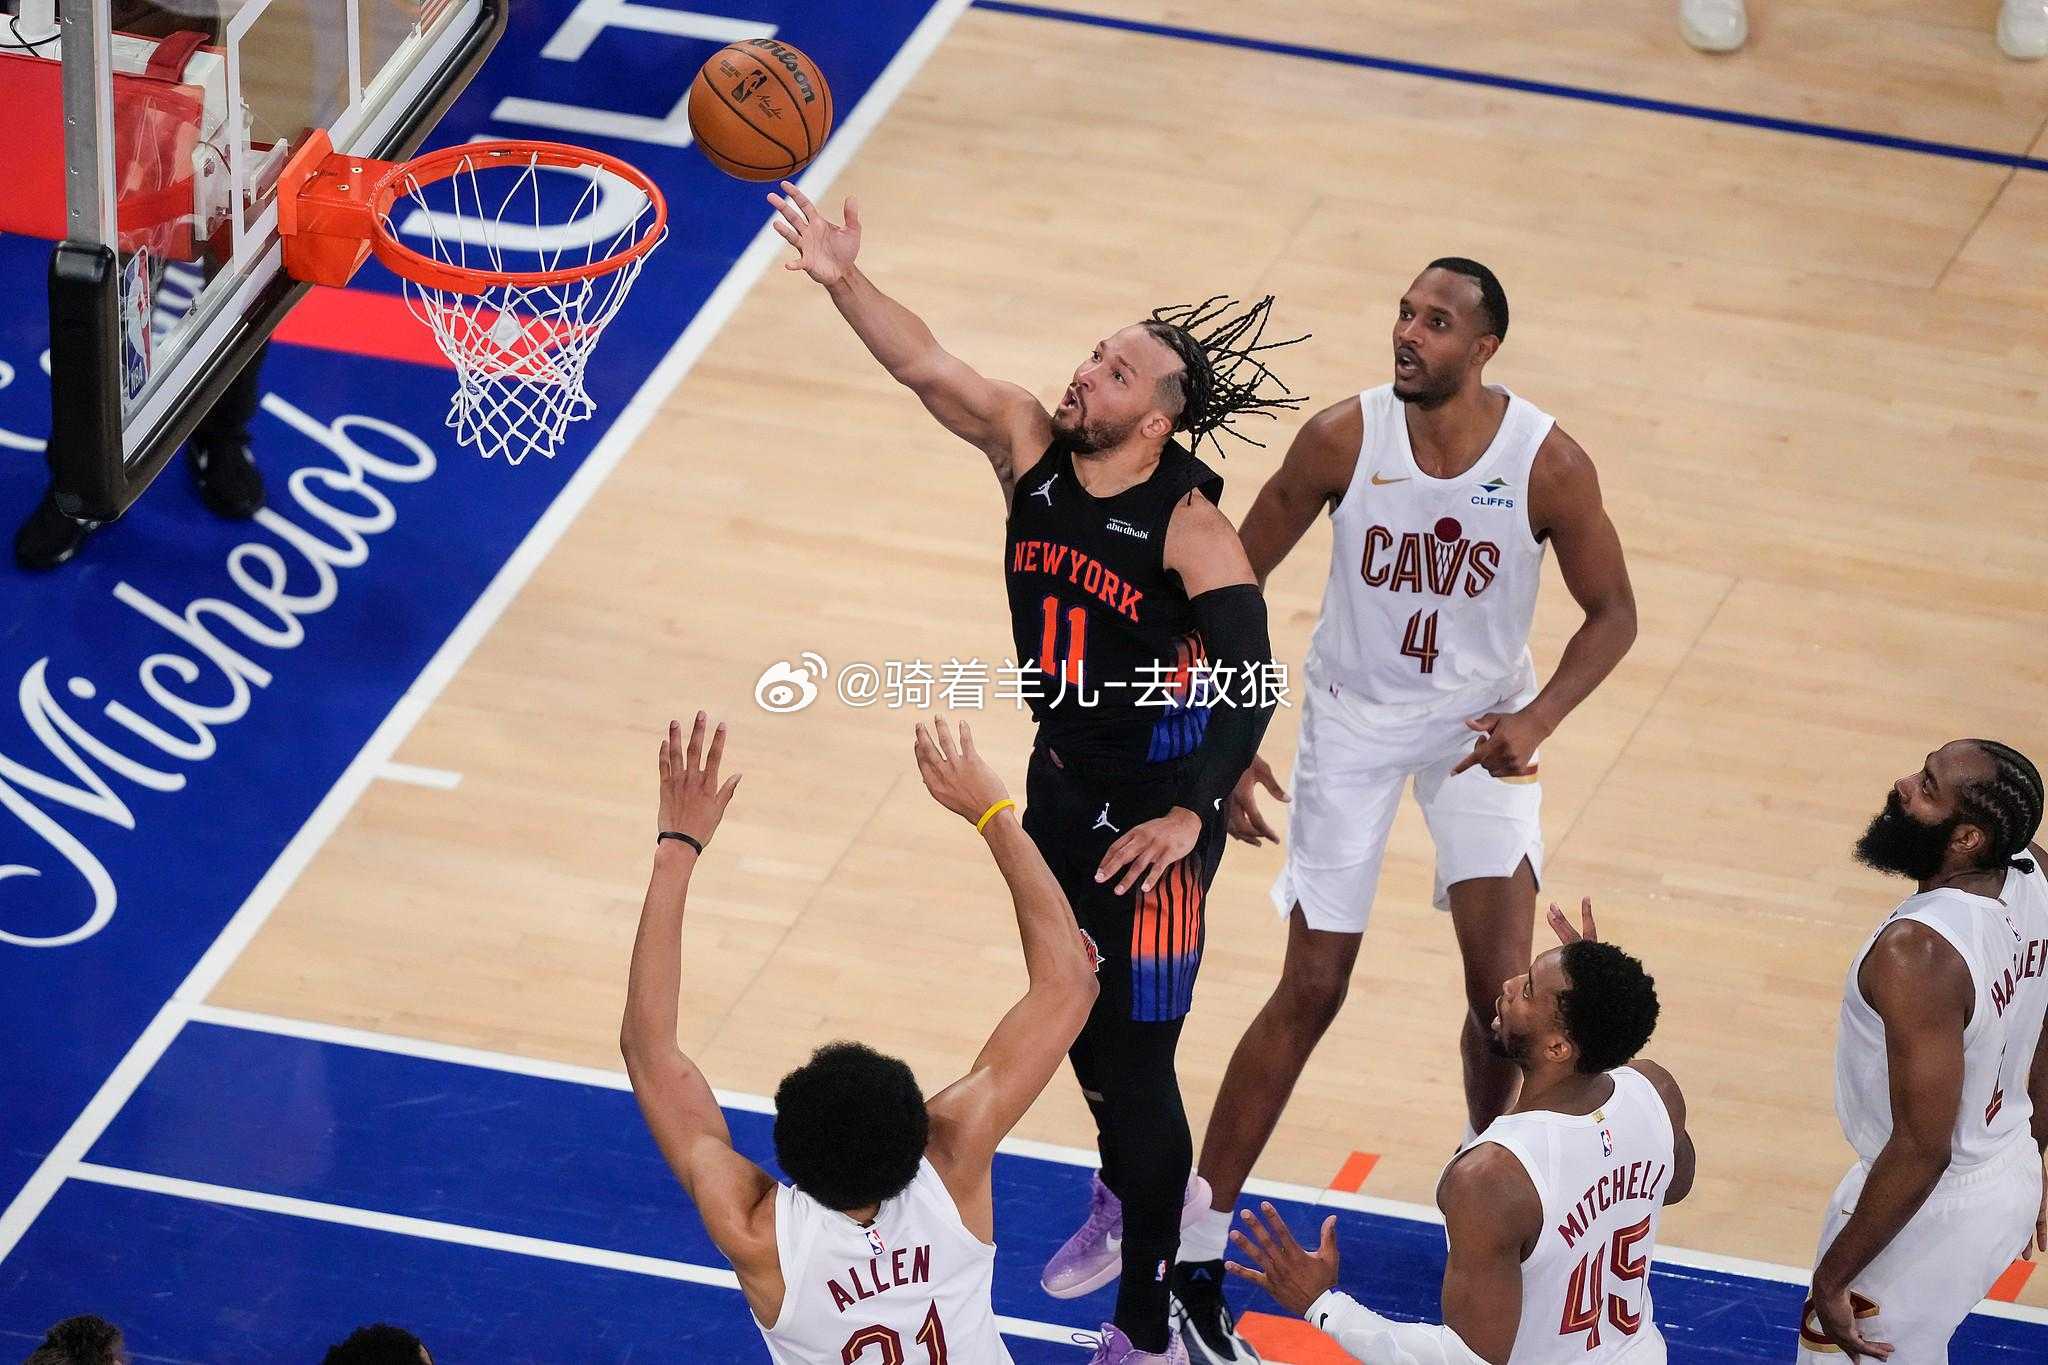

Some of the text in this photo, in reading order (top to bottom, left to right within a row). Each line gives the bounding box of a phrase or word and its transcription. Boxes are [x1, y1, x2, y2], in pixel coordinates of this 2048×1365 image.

[1106, 522, 1150, 540] abu dhabi
[1470, 495, 1514, 508] CLIFFS
[1013, 541, 1144, 623] NEW YORK
[1361, 522, 1501, 599] CAVS
[0, 392, 438, 948] Michelob
[1039, 594, 1088, 688] 11
[1400, 608, 1439, 674] 4
[1557, 1160, 1666, 1249] MITCHELL
[827, 1245, 931, 1314] ALLEN
[1559, 1213, 1651, 1351] 45
